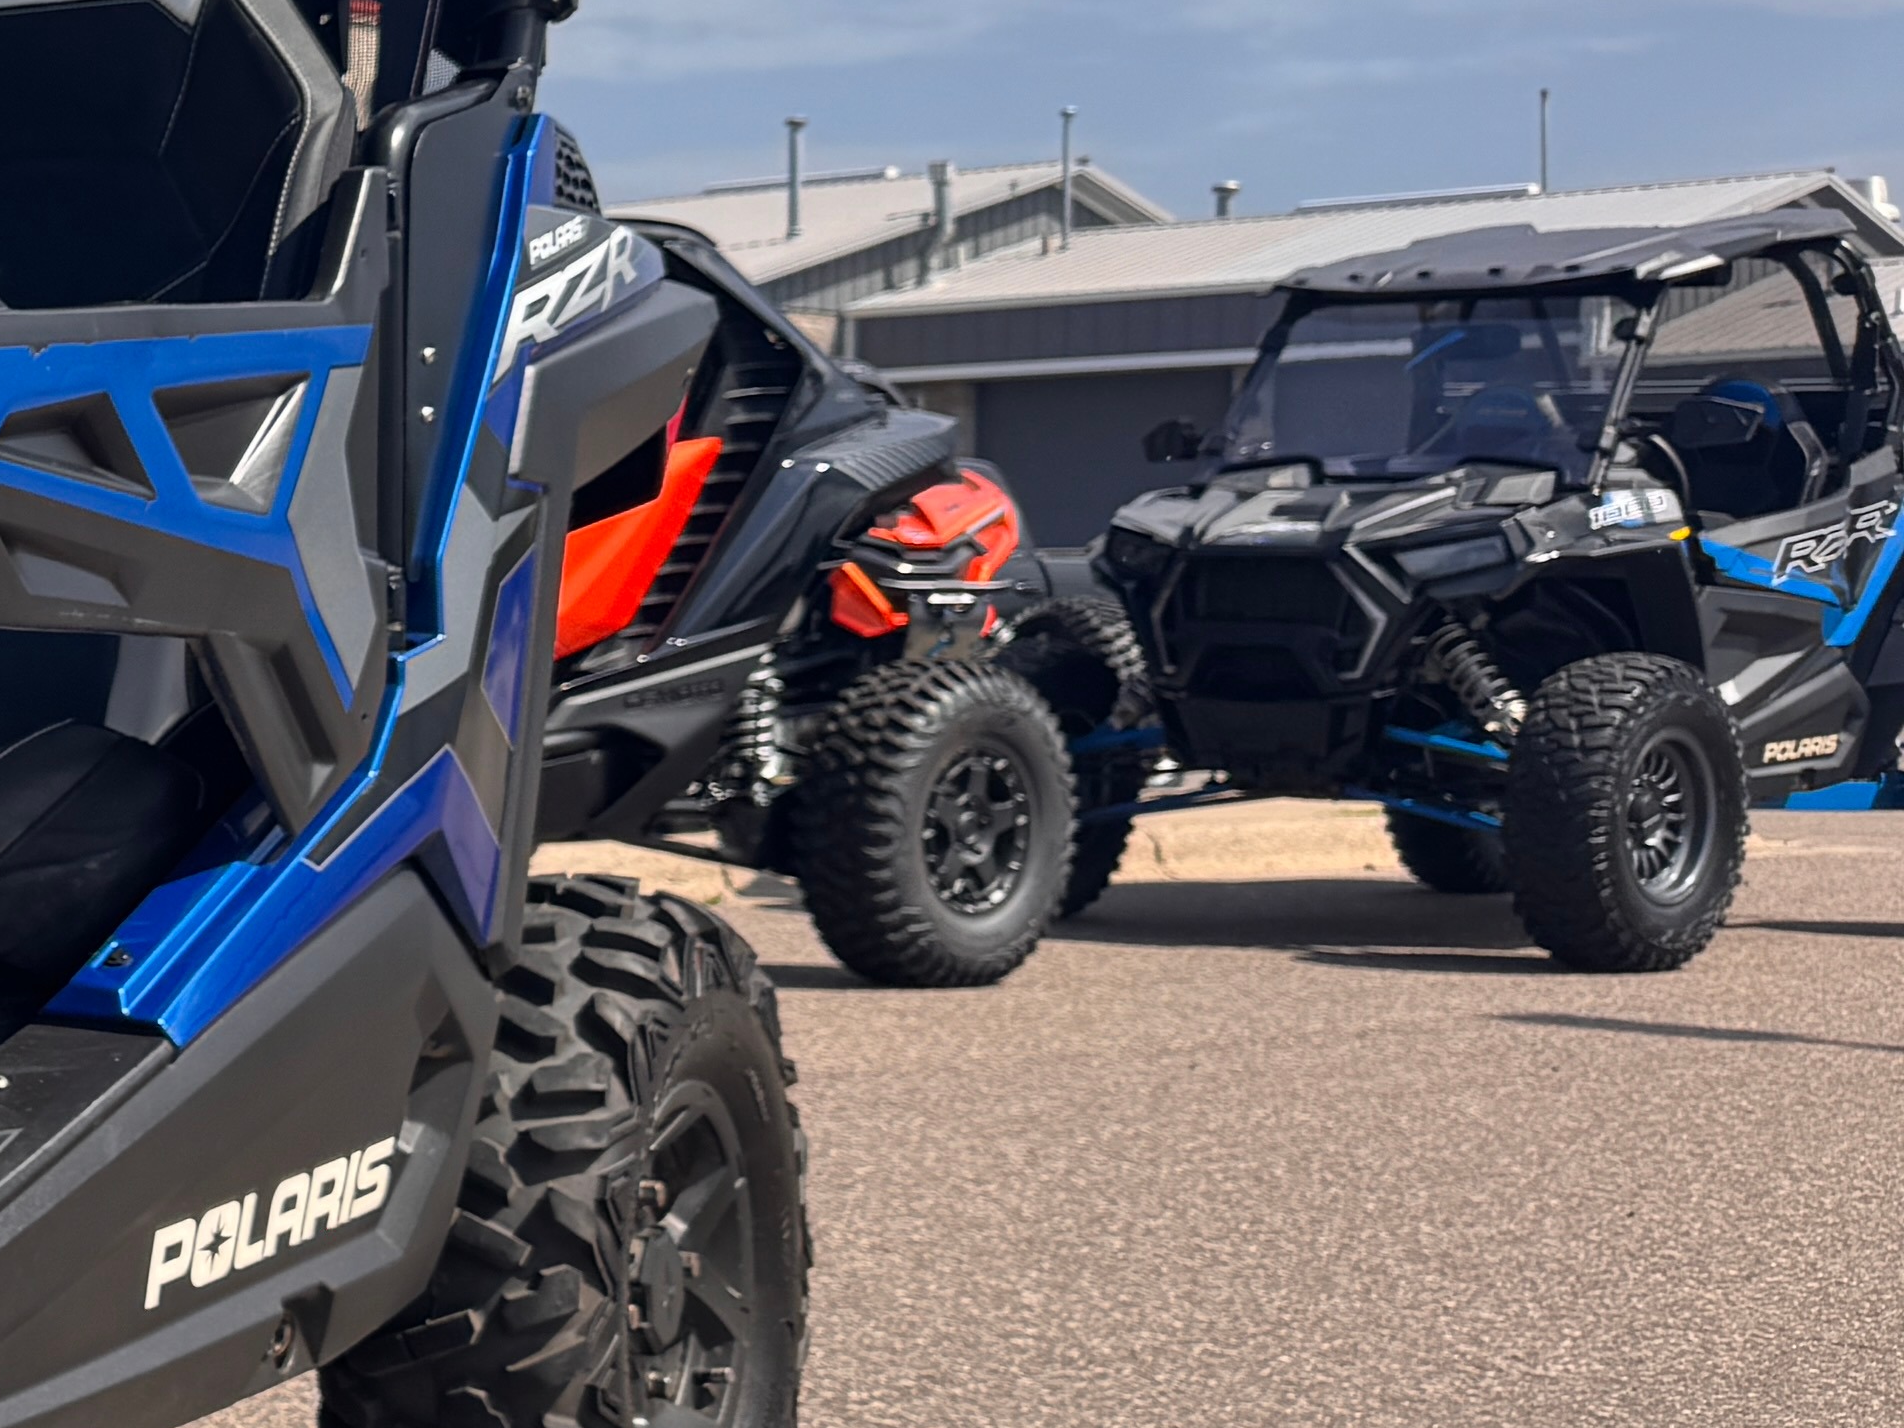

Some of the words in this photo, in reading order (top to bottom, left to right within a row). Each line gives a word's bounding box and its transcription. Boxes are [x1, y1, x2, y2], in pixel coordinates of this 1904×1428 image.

[529, 214, 586, 266] POLARIS
[492, 225, 637, 383] RZR
[1762, 733, 1840, 764] POLARIS
[144, 1136, 396, 1310] POLARIS
